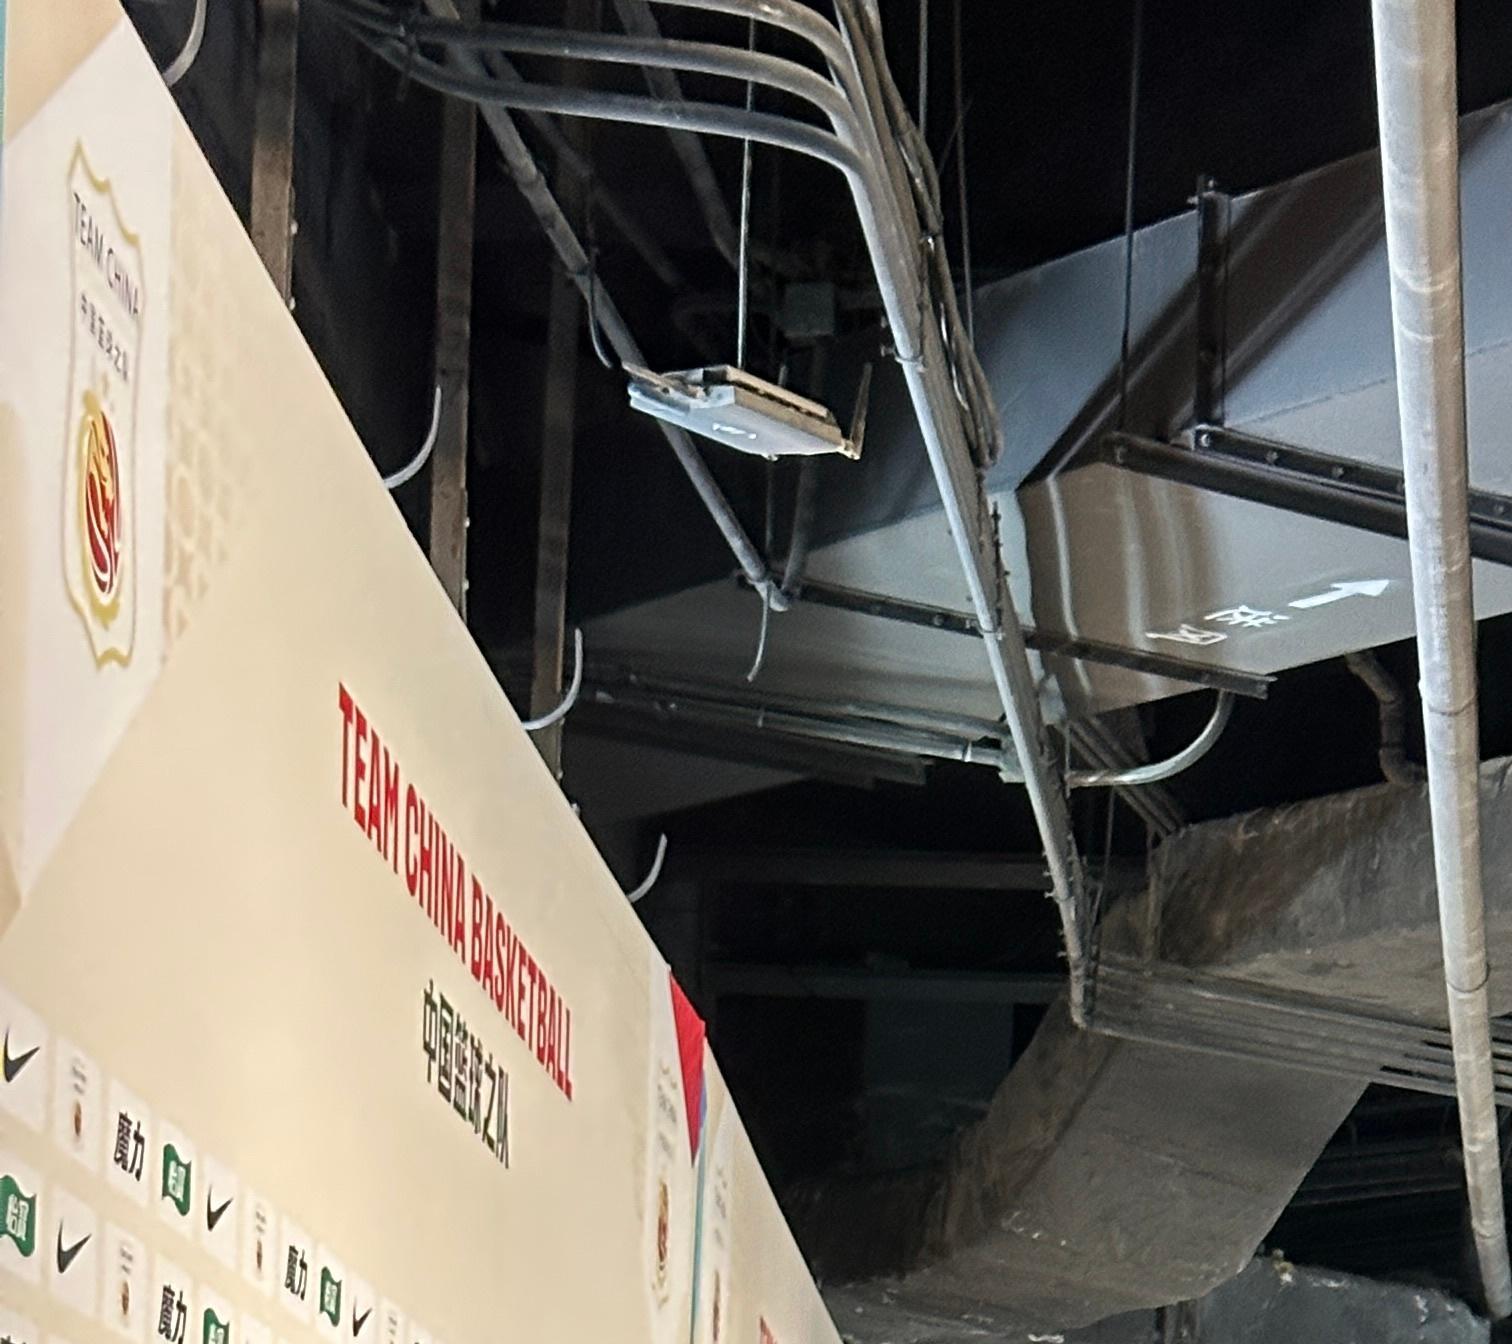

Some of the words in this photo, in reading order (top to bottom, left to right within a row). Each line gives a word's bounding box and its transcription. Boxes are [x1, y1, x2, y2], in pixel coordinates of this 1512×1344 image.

[74, 191, 104, 268] TEAM
[106, 247, 140, 316] CHINA
[338, 681, 401, 875] TEAM
[405, 782, 467, 966] CHINA
[470, 872, 573, 1104] BASKETBALL
[422, 978, 510, 1170] 中国篮球之队
